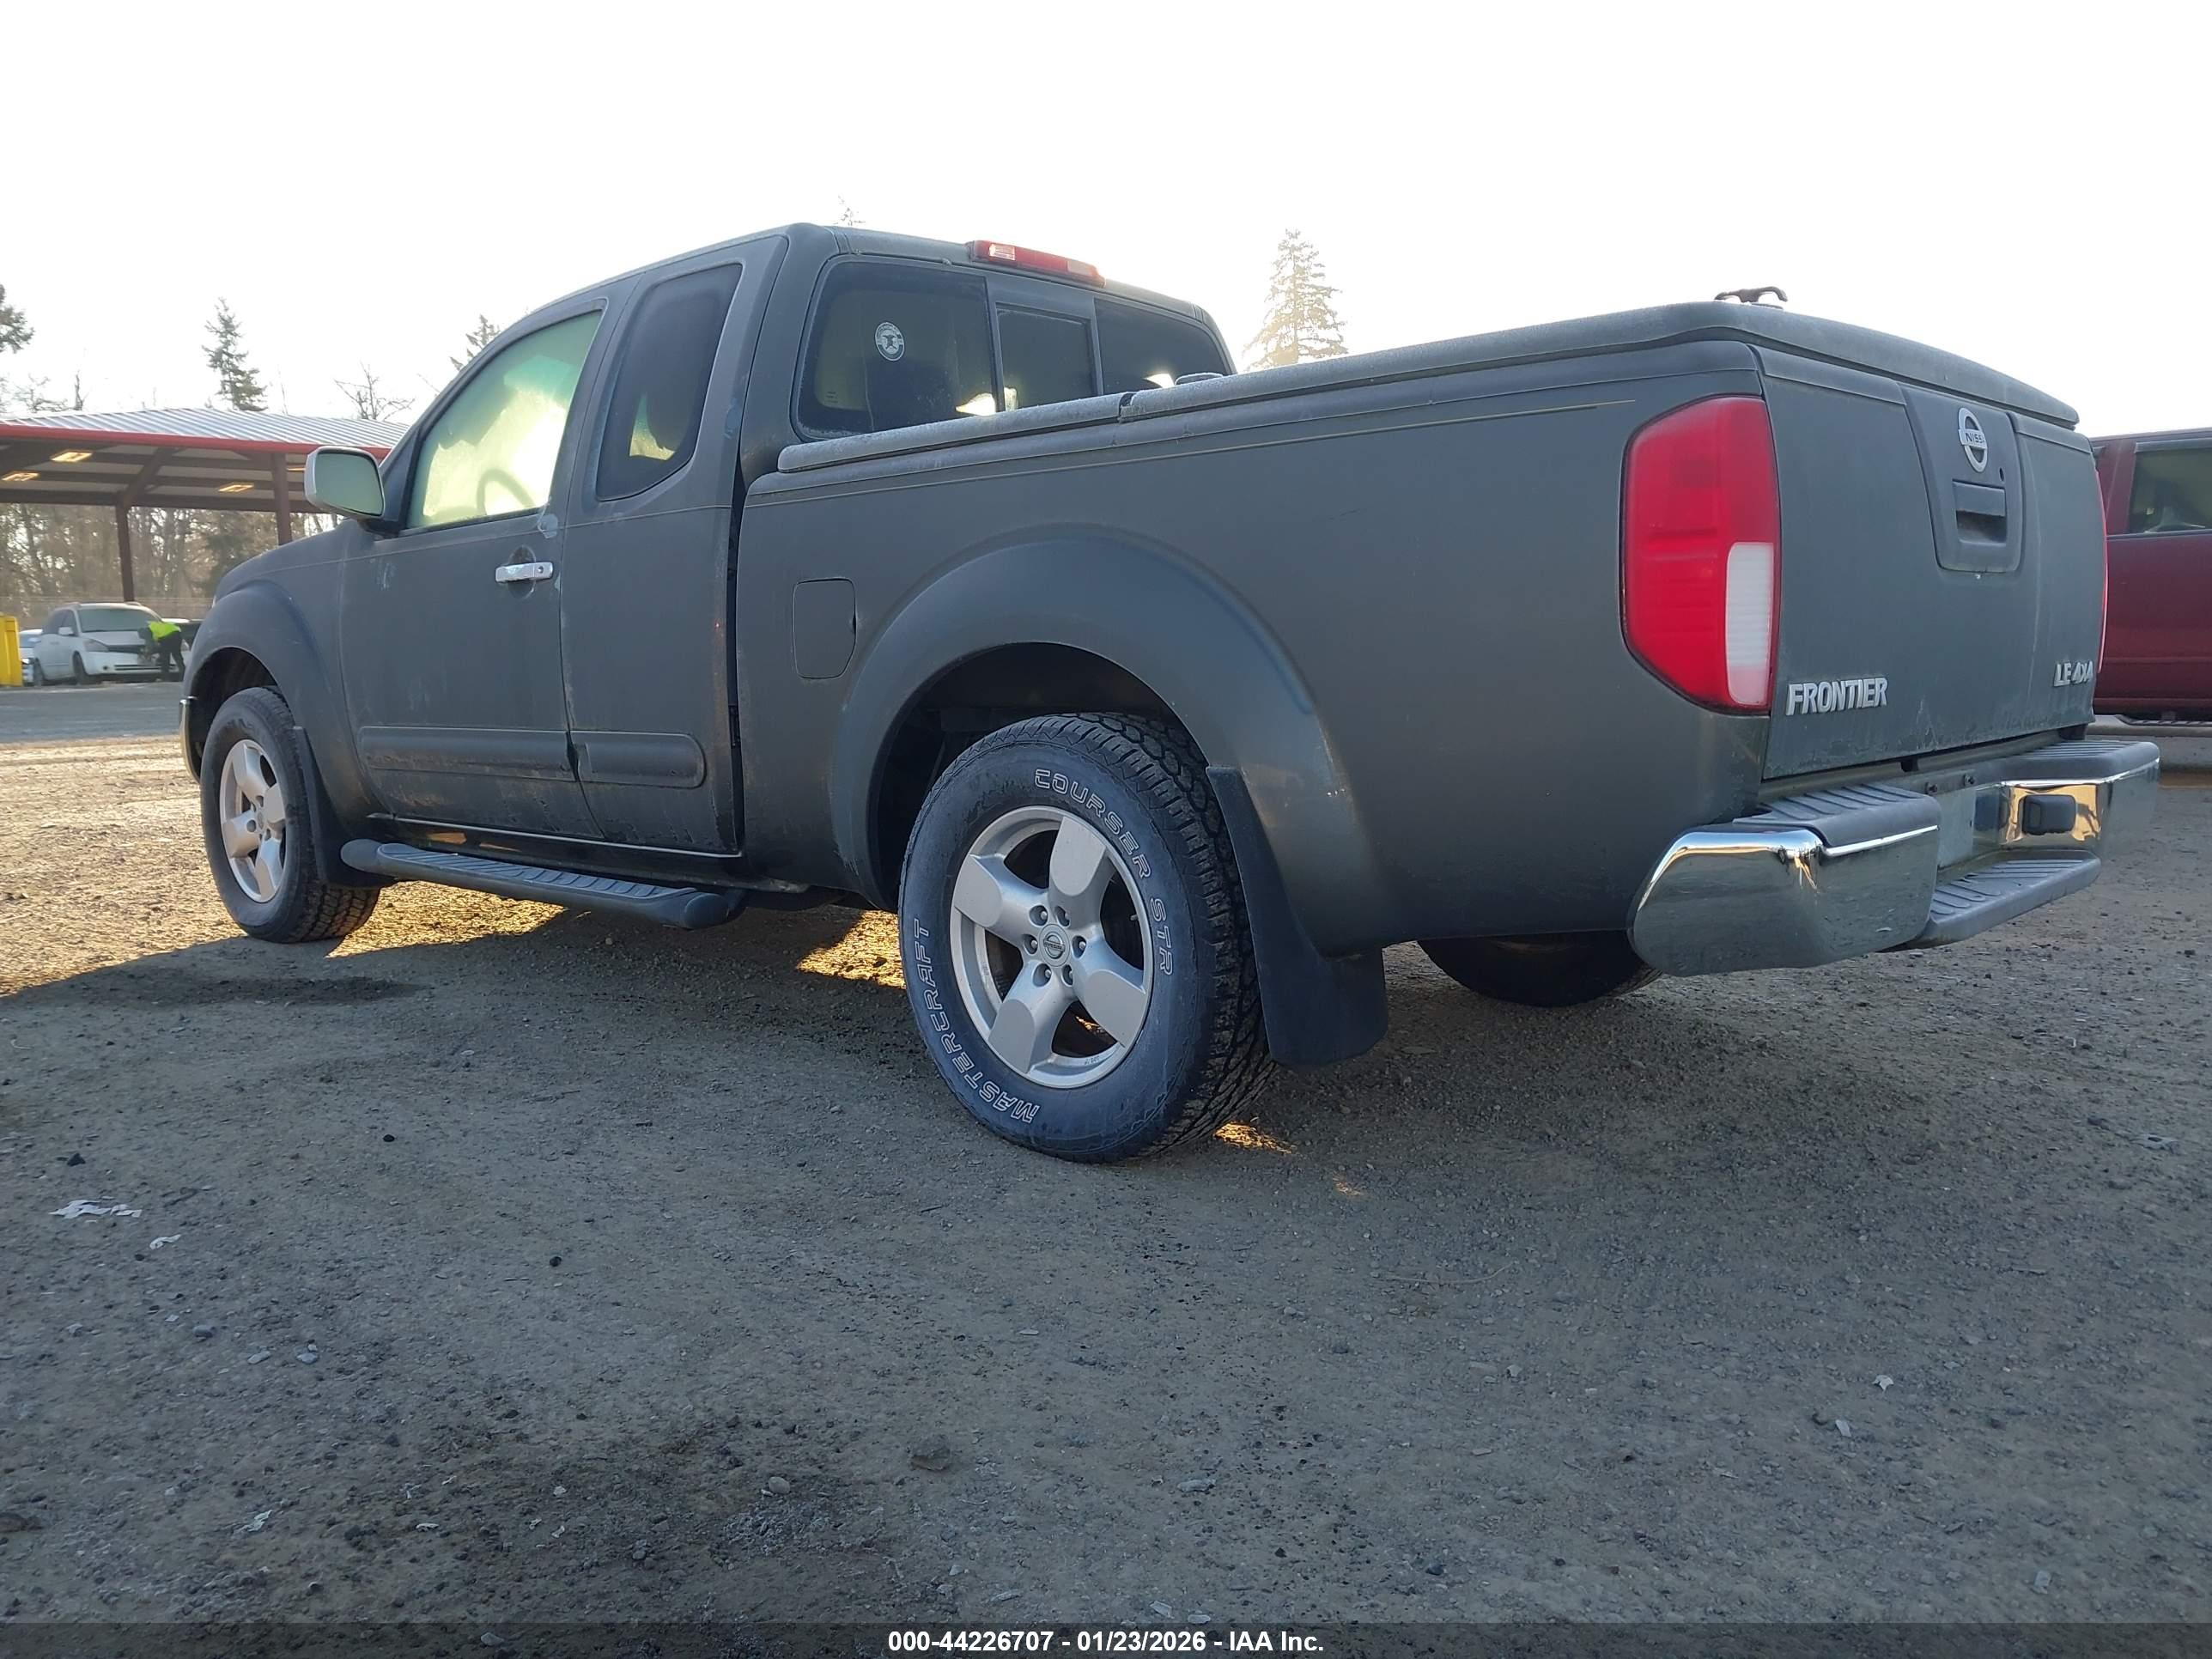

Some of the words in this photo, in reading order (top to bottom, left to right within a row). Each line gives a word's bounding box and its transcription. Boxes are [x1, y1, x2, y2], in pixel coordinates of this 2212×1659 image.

[1785, 678, 1888, 716] FRONTIER
[2053, 662, 2072, 687] LE
[1034, 769, 1152, 879] COURSER
[1149, 896, 1173, 976] STR
[913, 918, 1042, 1124] MASTERCRAFT
